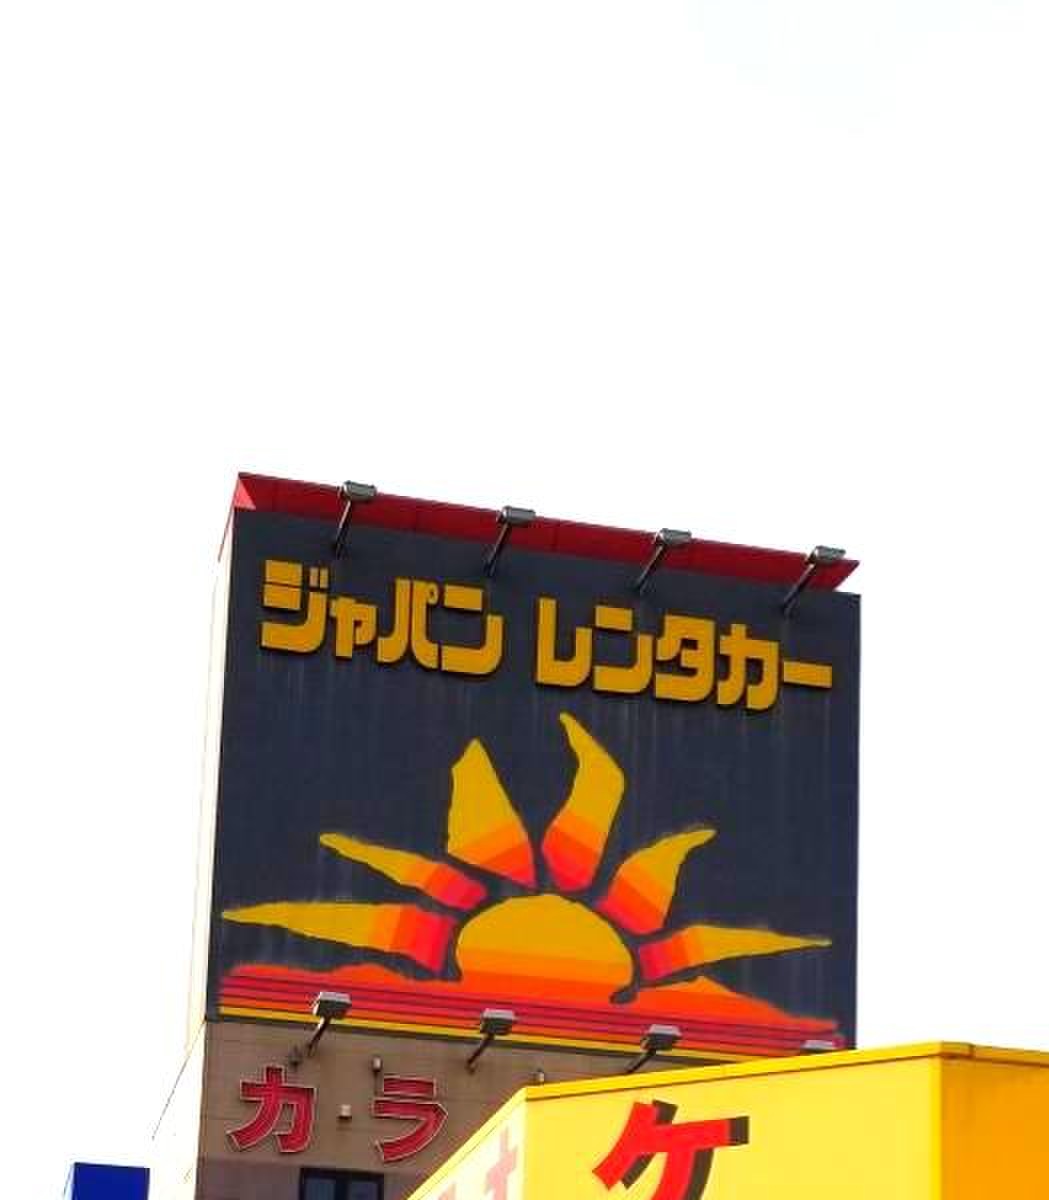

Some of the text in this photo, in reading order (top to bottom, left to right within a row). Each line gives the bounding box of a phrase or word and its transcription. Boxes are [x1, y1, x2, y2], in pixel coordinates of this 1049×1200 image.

[261, 559, 833, 710] ジャパン レンタカー
